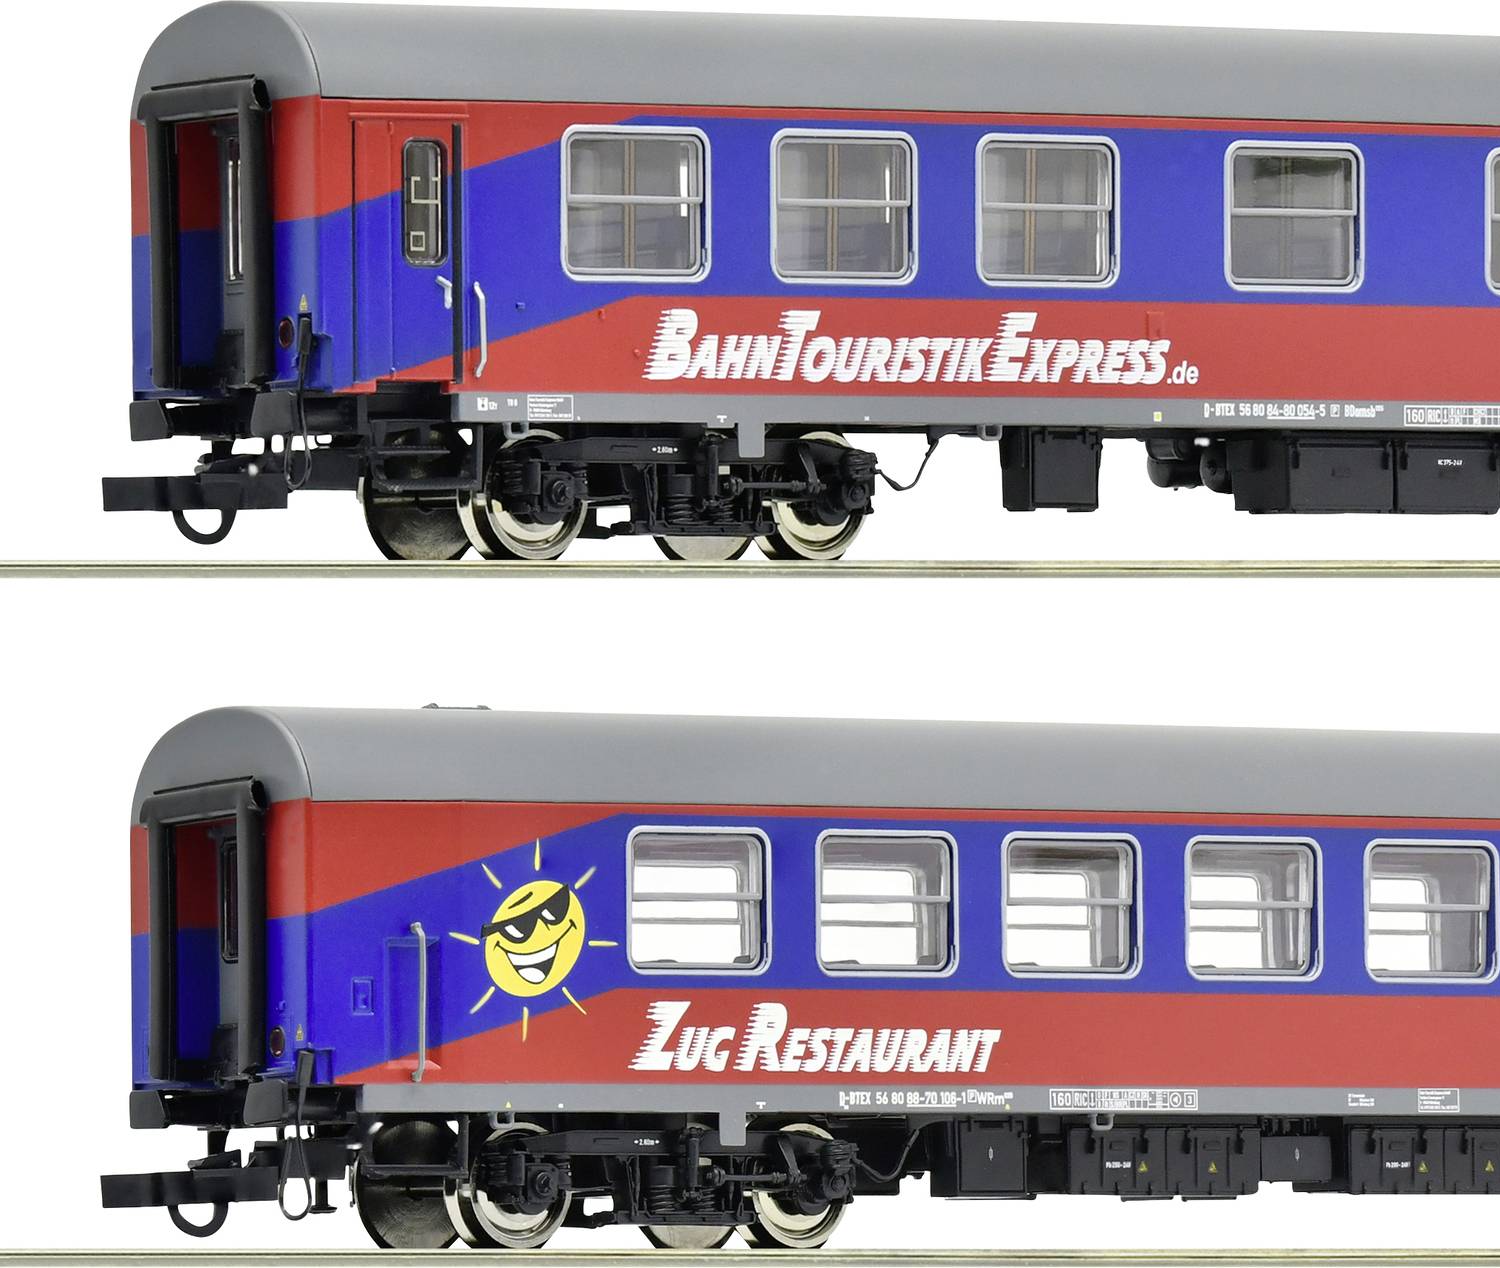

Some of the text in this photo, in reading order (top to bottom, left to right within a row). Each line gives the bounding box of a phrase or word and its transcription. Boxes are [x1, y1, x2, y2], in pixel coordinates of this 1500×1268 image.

[1239, 403, 1252, 416] 56
[1252, 403, 1265, 416] 80
[1406, 408, 1425, 424] 160
[875, 1091, 889, 1105] 56
[890, 1091, 905, 1105] 80
[906, 1091, 938, 1108] 88-70
[1052, 1092, 1071, 1107] 160
